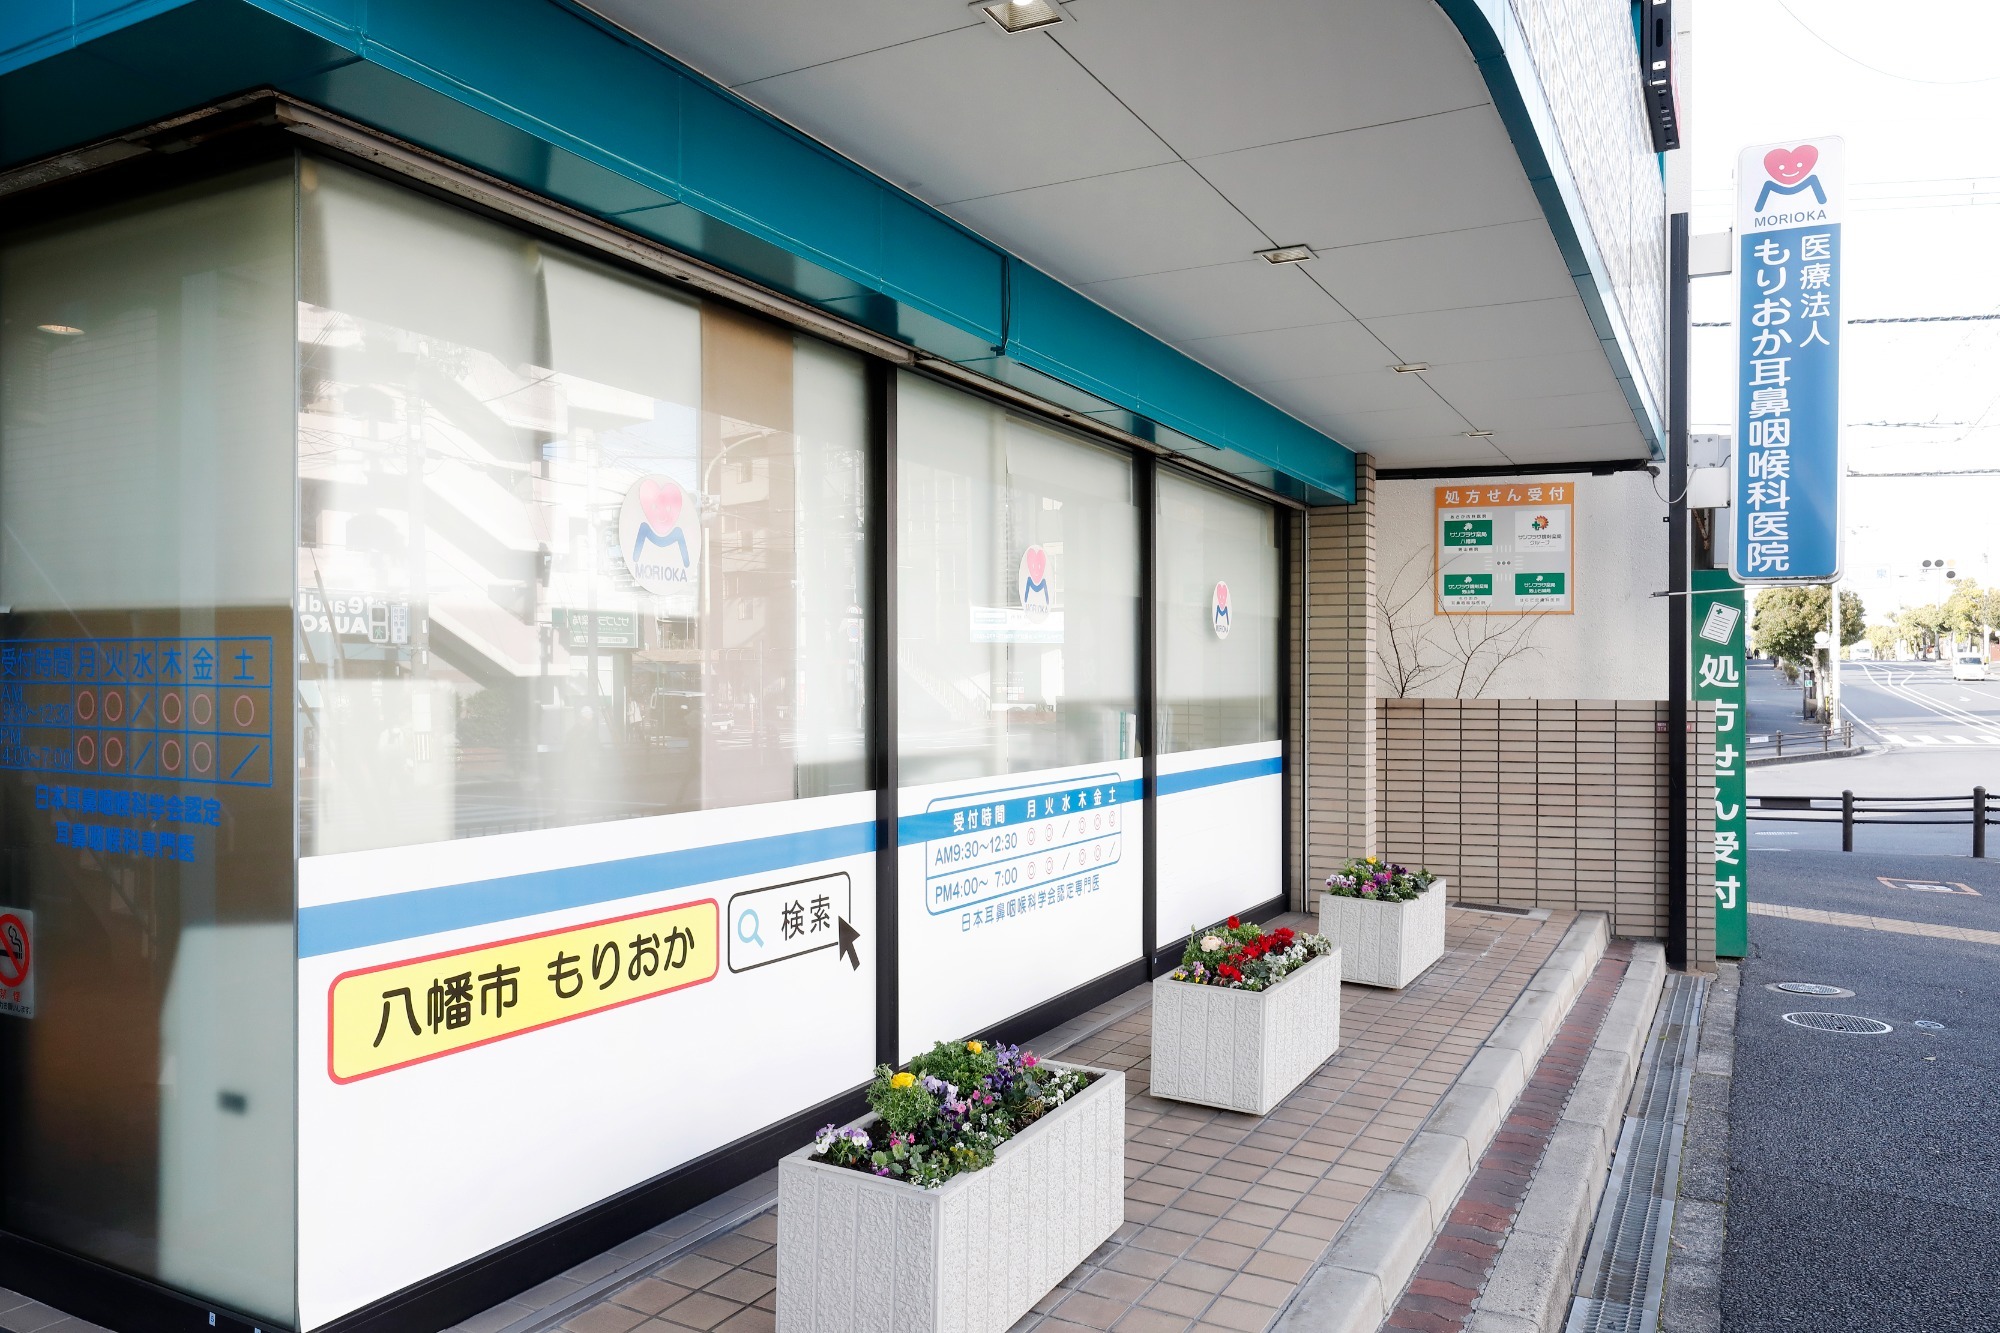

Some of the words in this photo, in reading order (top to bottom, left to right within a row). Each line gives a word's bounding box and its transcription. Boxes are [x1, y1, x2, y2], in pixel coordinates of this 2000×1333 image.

[1754, 209, 1827, 228] MORIOKA
[1799, 233, 1831, 348] 医療法人
[1746, 238, 1792, 573] もりおか耳鼻咽喉科医院
[1445, 487, 1565, 504] 処方せん受付
[635, 563, 688, 582] MORIOKA
[1, 647, 72, 678] 受付時間
[77, 648, 95, 678] 月
[104, 647, 123, 678] 火
[132, 648, 153, 678] 水
[162, 647, 182, 679] 木
[193, 647, 213, 680] 金
[233, 648, 254, 681] 土
[953, 805, 1005, 833] 受付時間
[1027, 800, 1036, 819] 月
[1044, 797, 1054, 816] 火
[1061, 794, 1071, 812] 水
[1078, 791, 1087, 809] 木
[1093, 788, 1103, 806] 金
[1108, 786, 1117, 803] 土
[781, 893, 831, 942] 検索
[961, 873, 1101, 933] 日本耳鼻咽喉科学会認定専門医
[373, 963, 521, 1048] 八幡市
[547, 925, 695, 999] もりおか
